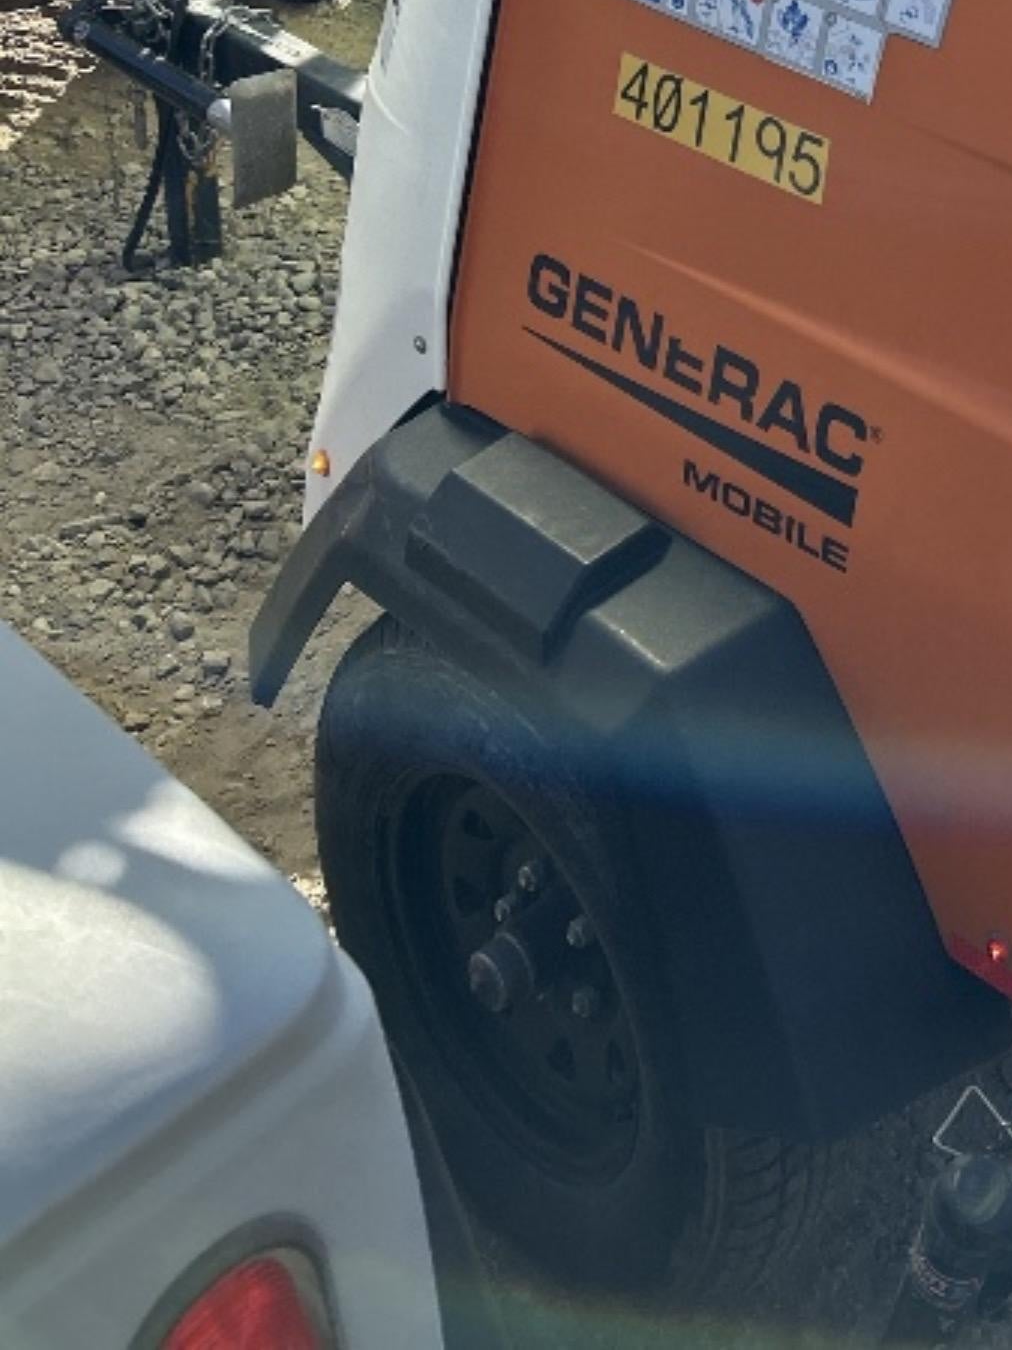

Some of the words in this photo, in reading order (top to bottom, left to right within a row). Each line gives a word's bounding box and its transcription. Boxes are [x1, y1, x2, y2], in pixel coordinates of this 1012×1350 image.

[620, 63, 824, 197] 401195
[526, 253, 869, 478] GENERAC
[682, 459, 849, 574] MOBILE
